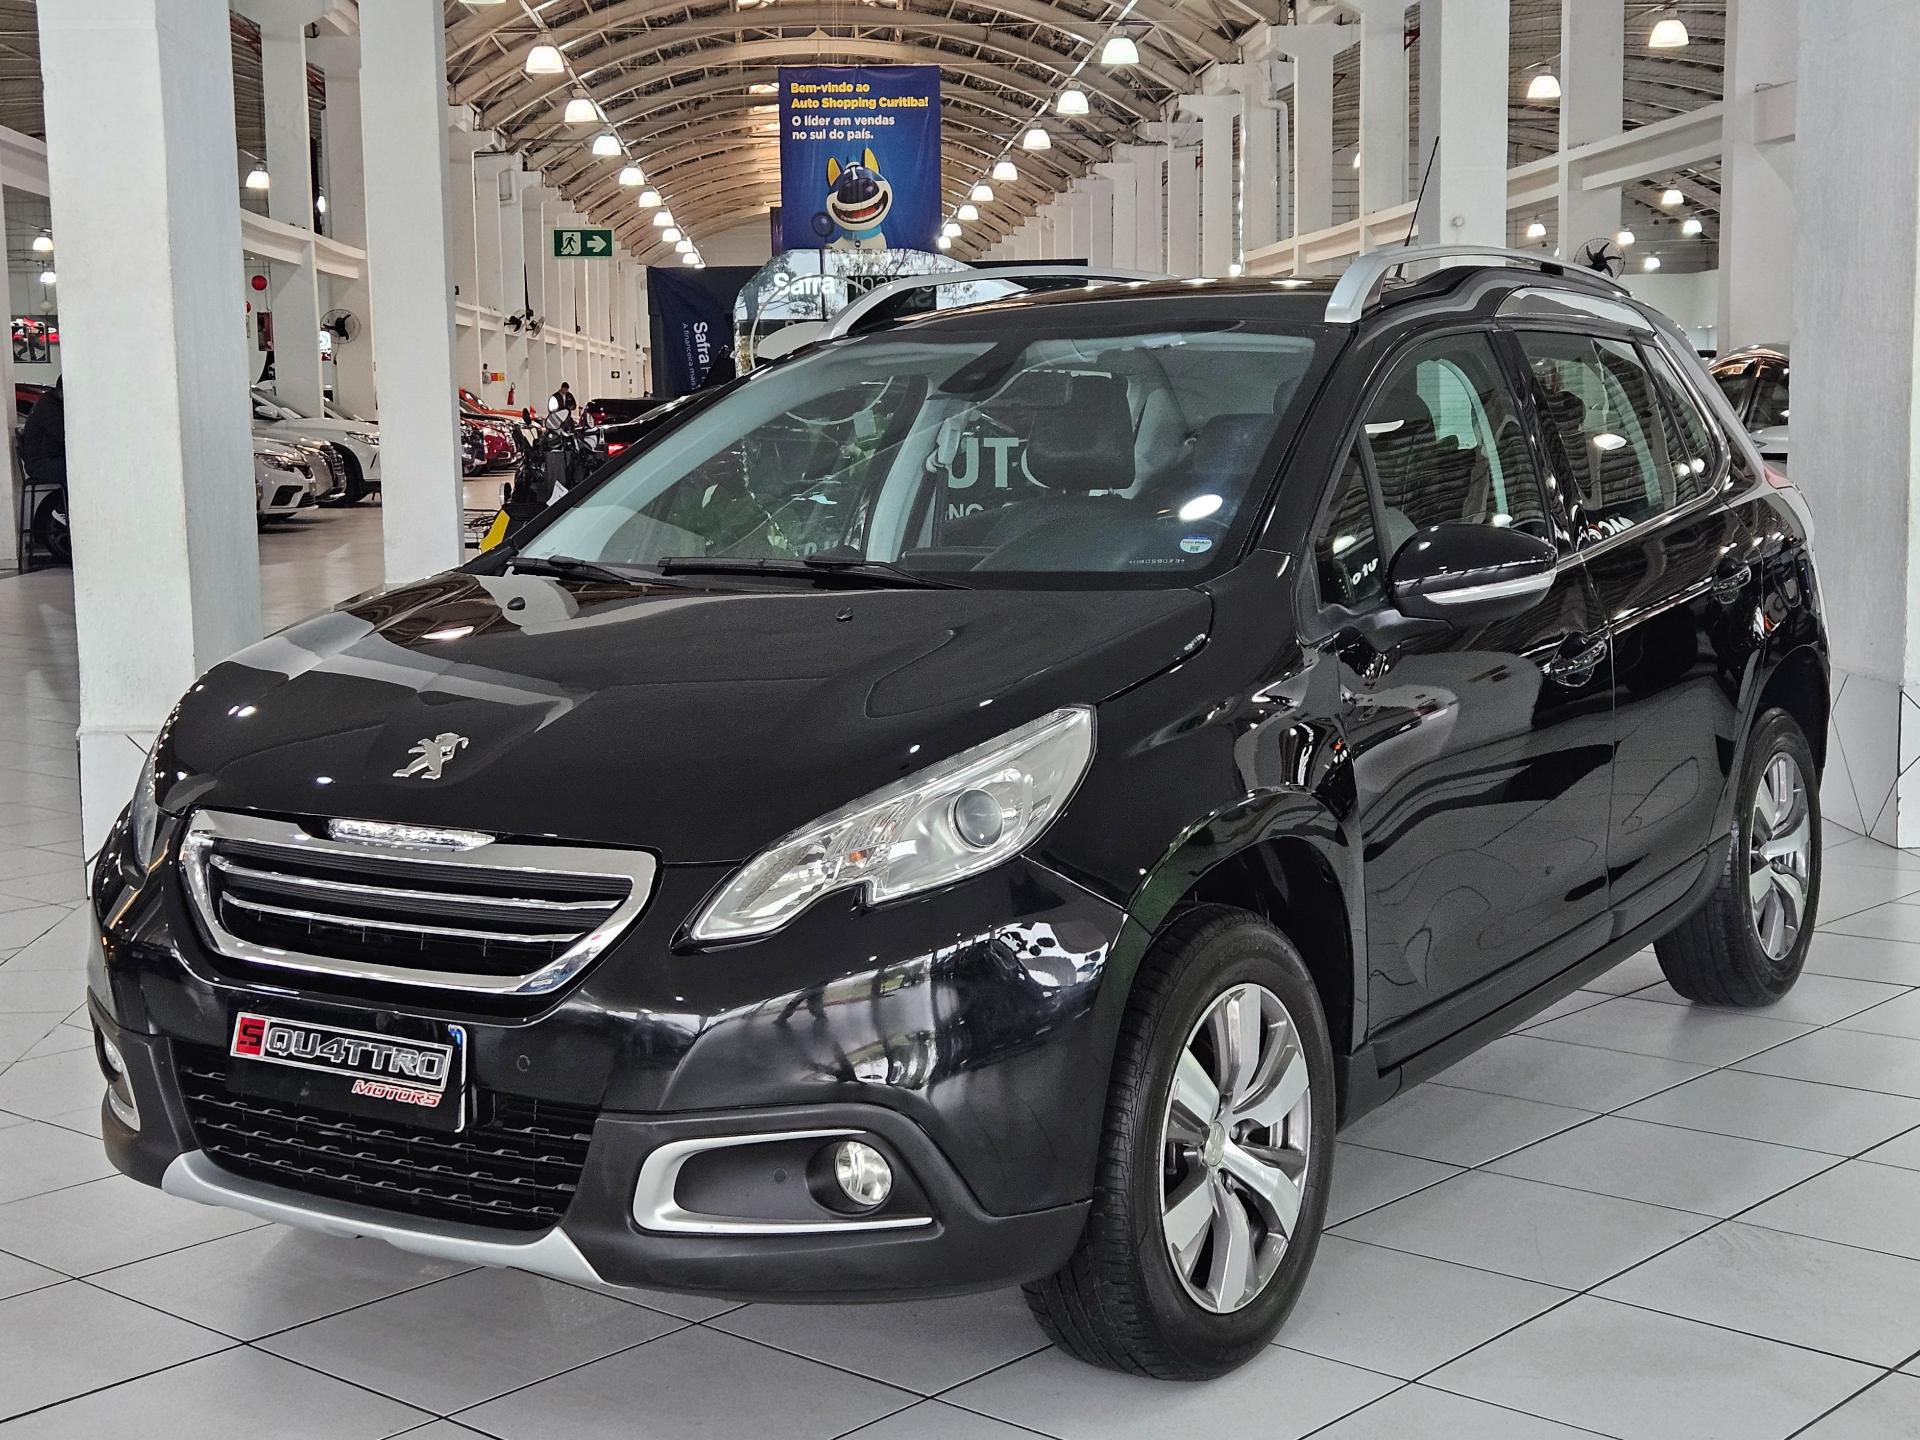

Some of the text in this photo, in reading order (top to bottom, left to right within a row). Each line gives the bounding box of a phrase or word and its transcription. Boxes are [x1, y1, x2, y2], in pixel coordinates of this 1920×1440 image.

[790, 82, 870, 94] Bem-vindo ao
[791, 96, 929, 110] Auto Shopping Curitiba!
[791, 114, 895, 126] O líder em vendas
[792, 128, 874, 141] no sul do país.
[773, 272, 836, 296] Safra
[693, 321, 711, 364] Safra
[351, 1079, 442, 1108] MOTORS
